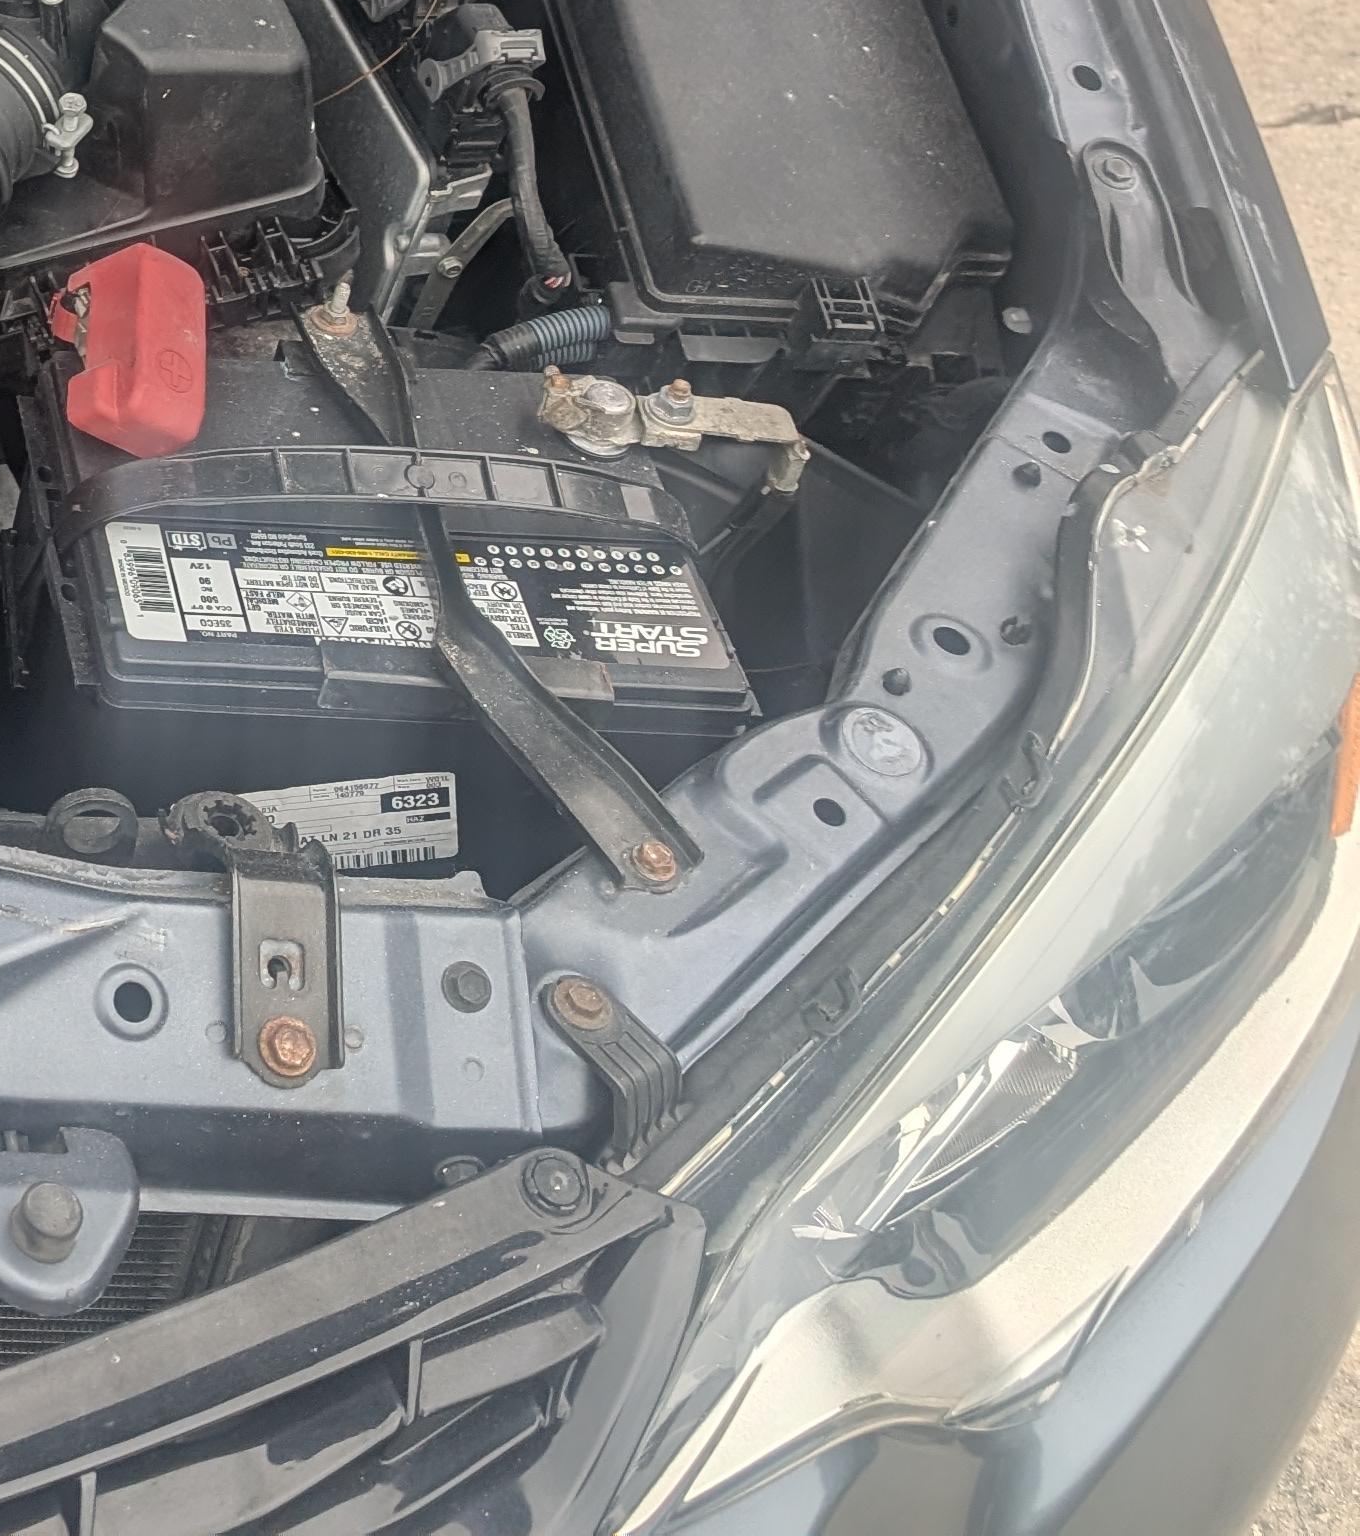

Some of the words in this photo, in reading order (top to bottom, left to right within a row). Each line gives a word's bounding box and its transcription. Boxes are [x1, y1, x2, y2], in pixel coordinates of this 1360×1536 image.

[172, 533, 201, 547] STD
[211, 535, 233, 546] Pb
[189, 562, 212, 570] 12V
[198, 576, 211, 585] 90
[242, 579, 275, 587] BATTERY.
[326, 577, 377, 585] INSTRUCTIONS.
[347, 583, 360, 591] ALL
[242, 590, 264, 598] FAST.
[472, 589, 489, 597] KEEP
[200, 595, 219, 604] 500
[244, 597, 279, 605] MEDICAL
[484, 601, 510, 609] INJURY.
[264, 611, 293, 619] WATER.
[294, 612, 316, 620] WITH
[345, 609, 368, 617] CAUSE
[511, 608, 525, 616] CAN
[365, 617, 384, 625] ACID
[402, 613, 430, 621] SPARKS
[265, 618, 319, 627] IMMEDIATELY
[273, 625, 294, 633] EYES
[295, 626, 320, 635] FLUSH
[348, 624, 387, 633] SULFURIC
[506, 623, 531, 631] EYES.
[505, 631, 534, 640] SHIELD
[591, 622, 709, 645] START
[595, 638, 702, 658] SUPER
[392, 792, 440, 809] 6323
[406, 815, 425, 823] HAZ
[321, 833, 338, 843] LN
[343, 831, 358, 841] 21
[363, 828, 381, 839] DR
[385, 826, 402, 836] 35
